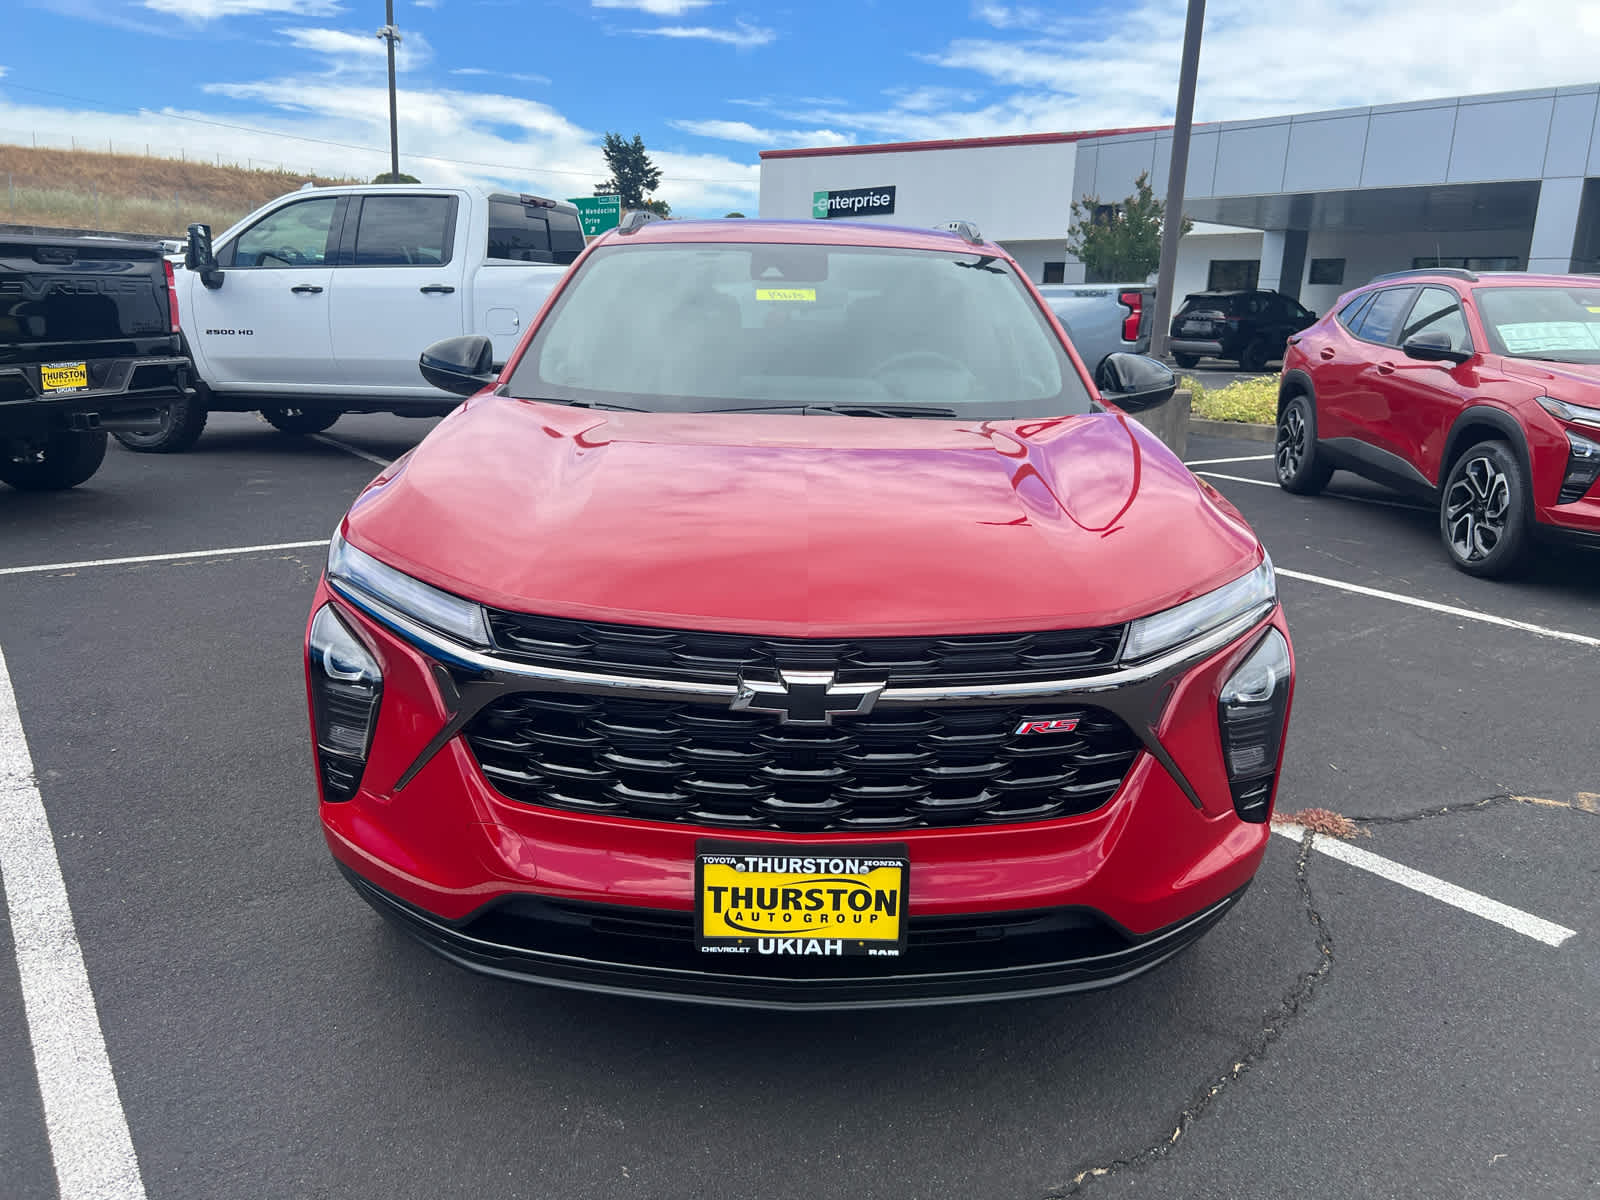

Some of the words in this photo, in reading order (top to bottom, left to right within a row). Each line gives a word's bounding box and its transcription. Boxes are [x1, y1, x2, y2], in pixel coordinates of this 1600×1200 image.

[817, 191, 890, 212] enterprise
[585, 207, 617, 215] Mendocino
[584, 217, 601, 225] Drive
[42, 370, 86, 382] THURSTON
[1015, 718, 1080, 735] RS
[702, 856, 737, 865] TOYOTA
[744, 857, 859, 874] THURSTON
[707, 885, 898, 917] THURSTON
[735, 912, 793, 923] AUTO
[803, 913, 879, 924] GROUP
[701, 946, 751, 954] CHEVROLET
[757, 938, 843, 956] UKIAH
